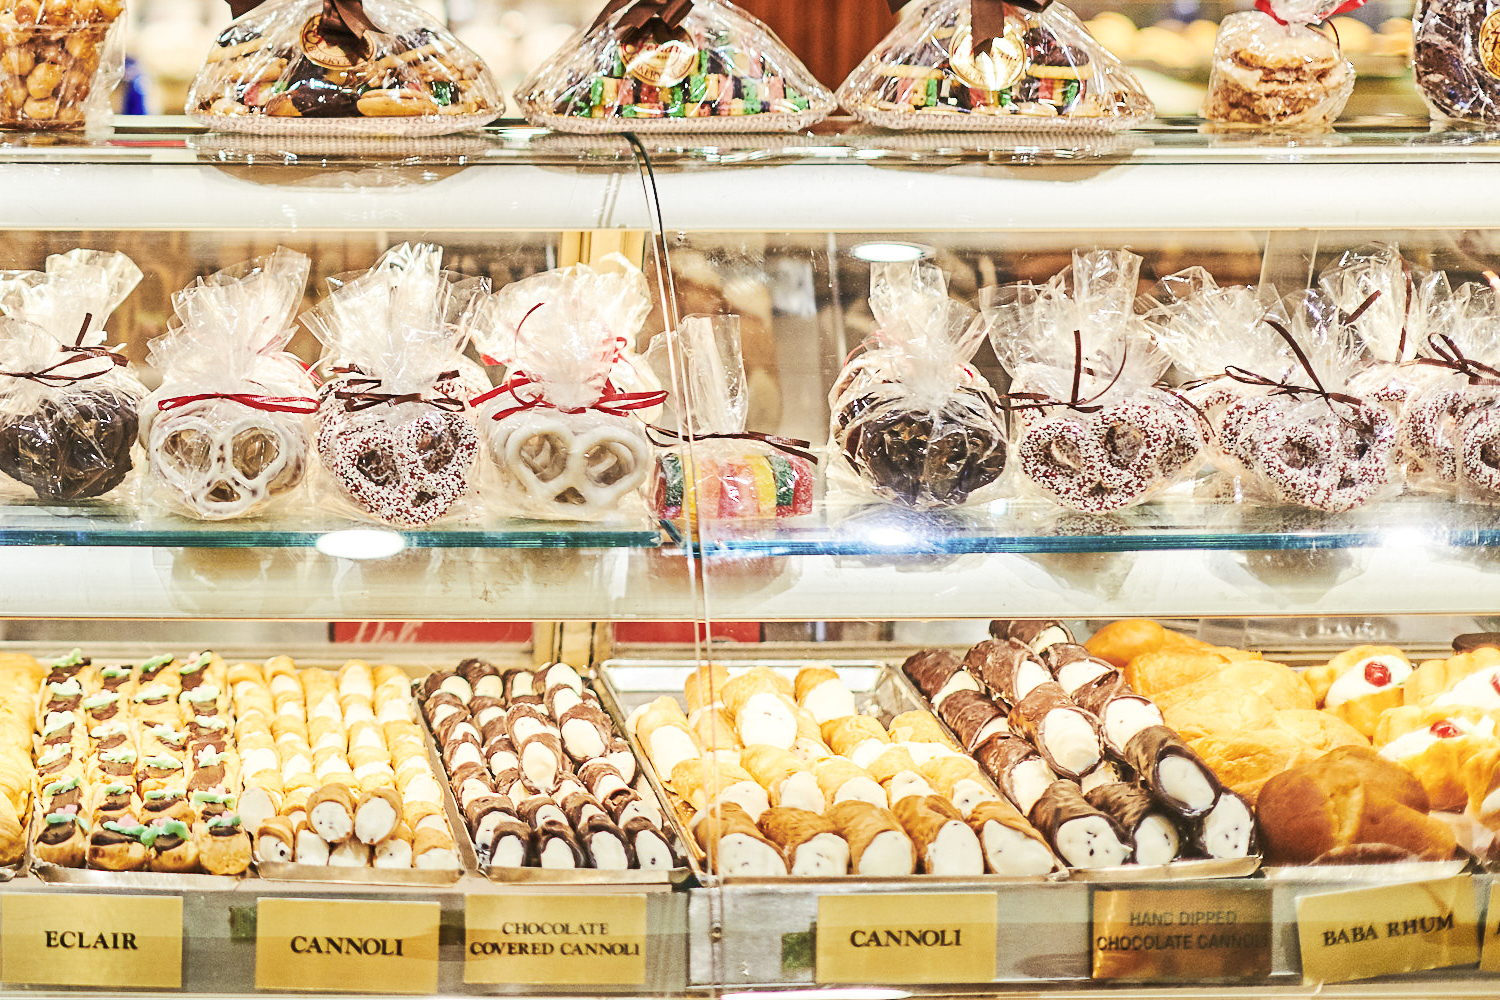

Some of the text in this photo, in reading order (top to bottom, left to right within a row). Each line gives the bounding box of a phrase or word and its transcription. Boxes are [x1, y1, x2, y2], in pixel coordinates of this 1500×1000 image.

[1129, 910, 1237, 927] HAND DIPPED
[502, 921, 609, 936] CHOCOLATE
[1322, 912, 1454, 947] BABA RHUM
[45, 930, 139, 950] ECLAIR
[290, 936, 404, 957] CANNOLI
[850, 929, 962, 948] CANNOLI
[1097, 935, 1193, 951] CHOCOLATE
[469, 941, 640, 956] COVERED CANNOLI
